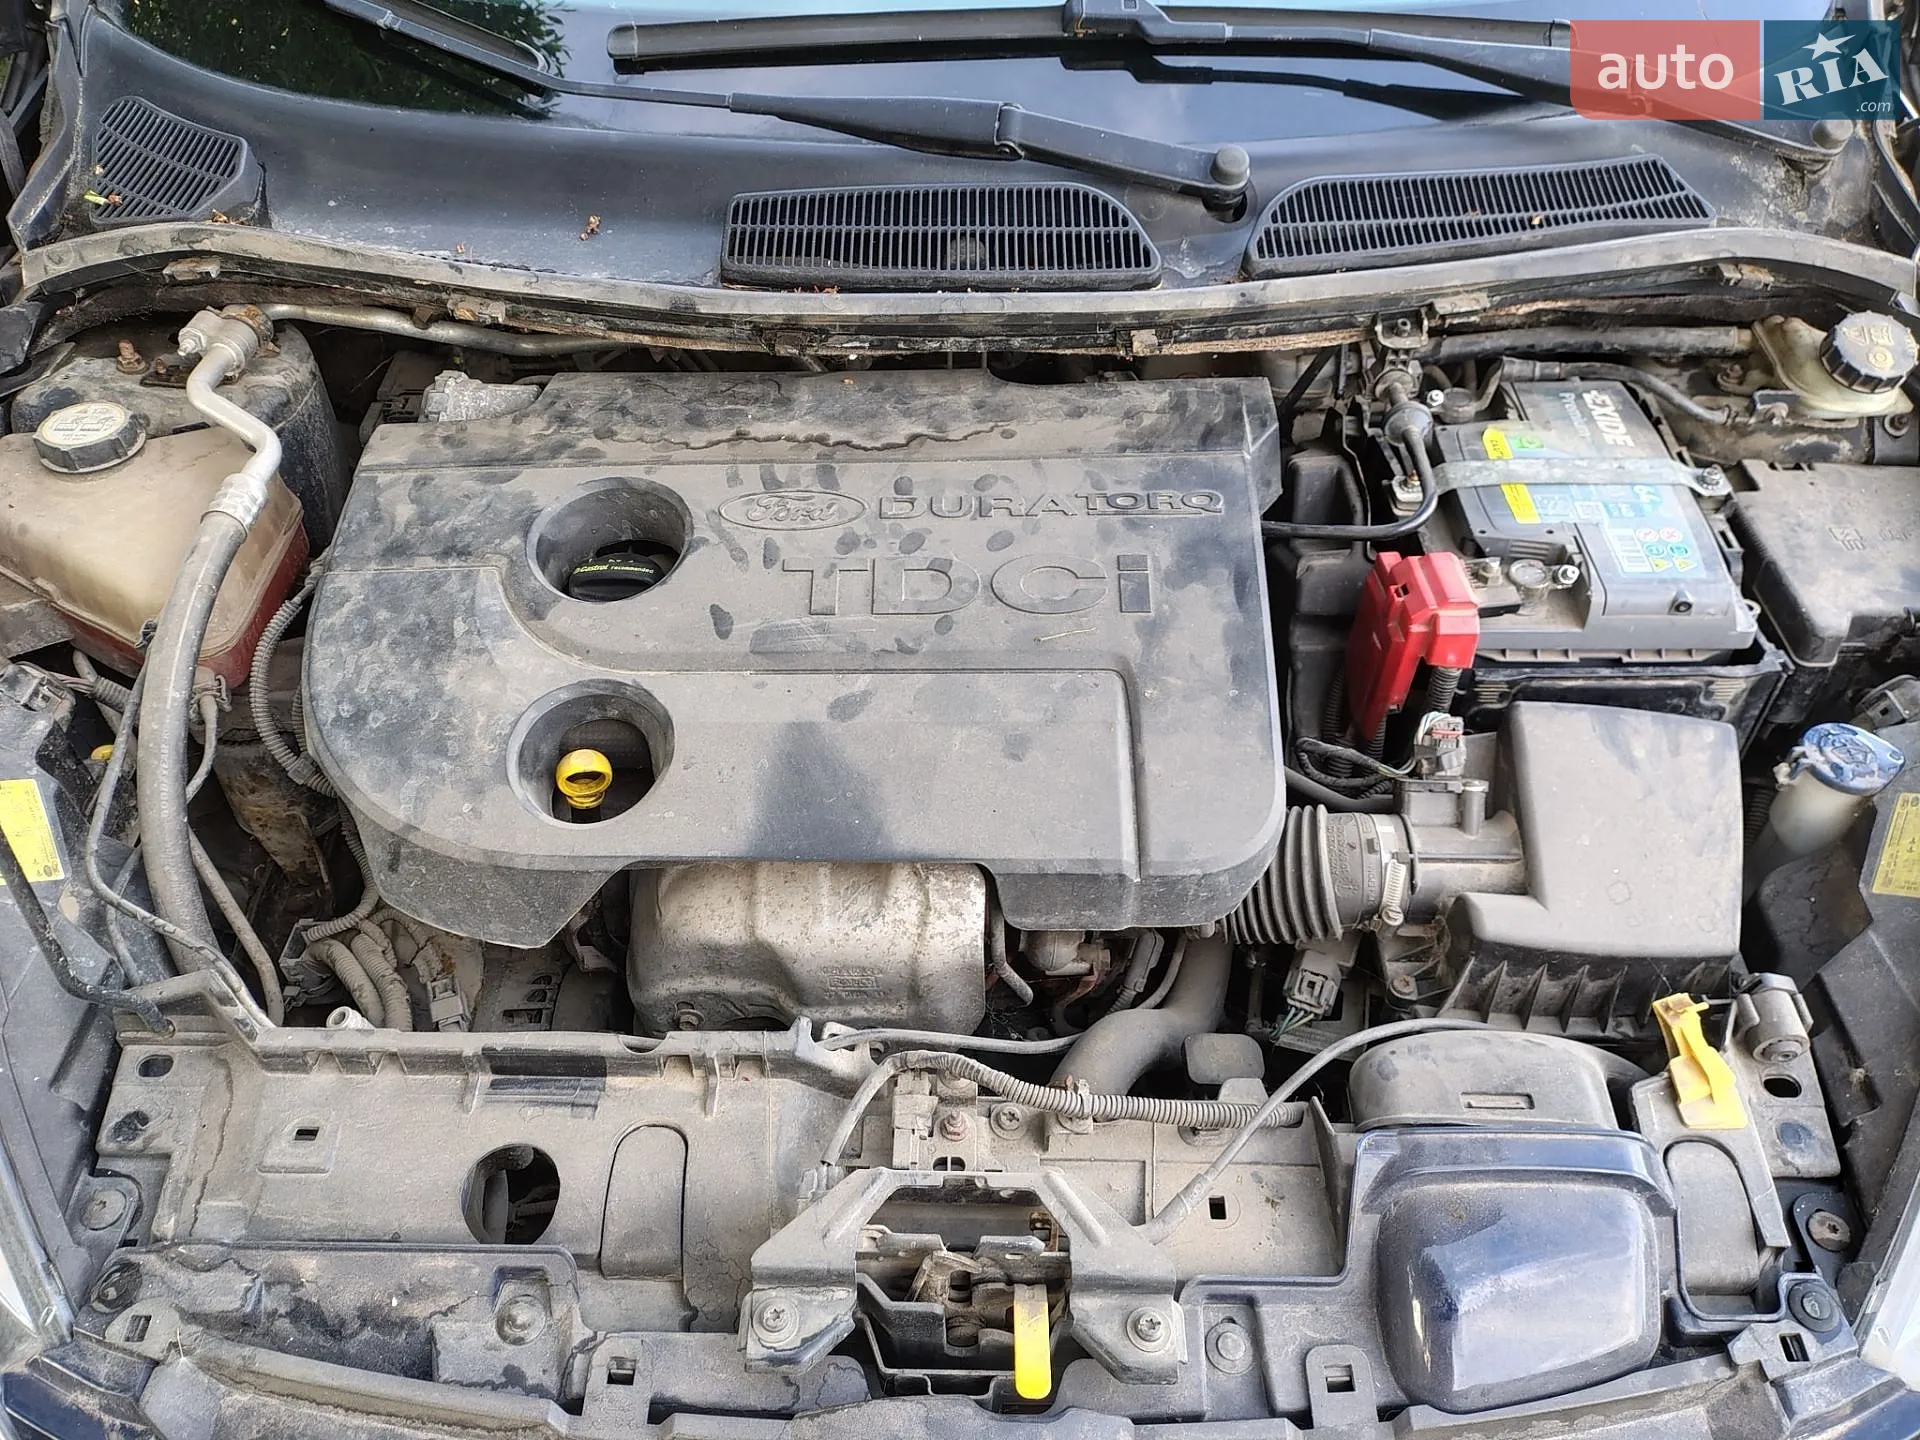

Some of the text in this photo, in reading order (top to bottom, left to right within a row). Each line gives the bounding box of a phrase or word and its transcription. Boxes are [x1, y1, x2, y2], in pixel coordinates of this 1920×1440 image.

[1582, 389, 1636, 448] EXIDE
[744, 491, 1225, 524] Ford DURATORQ
[580, 563, 655, 574] Castrol recommended
[781, 552, 1154, 617] TDCi
